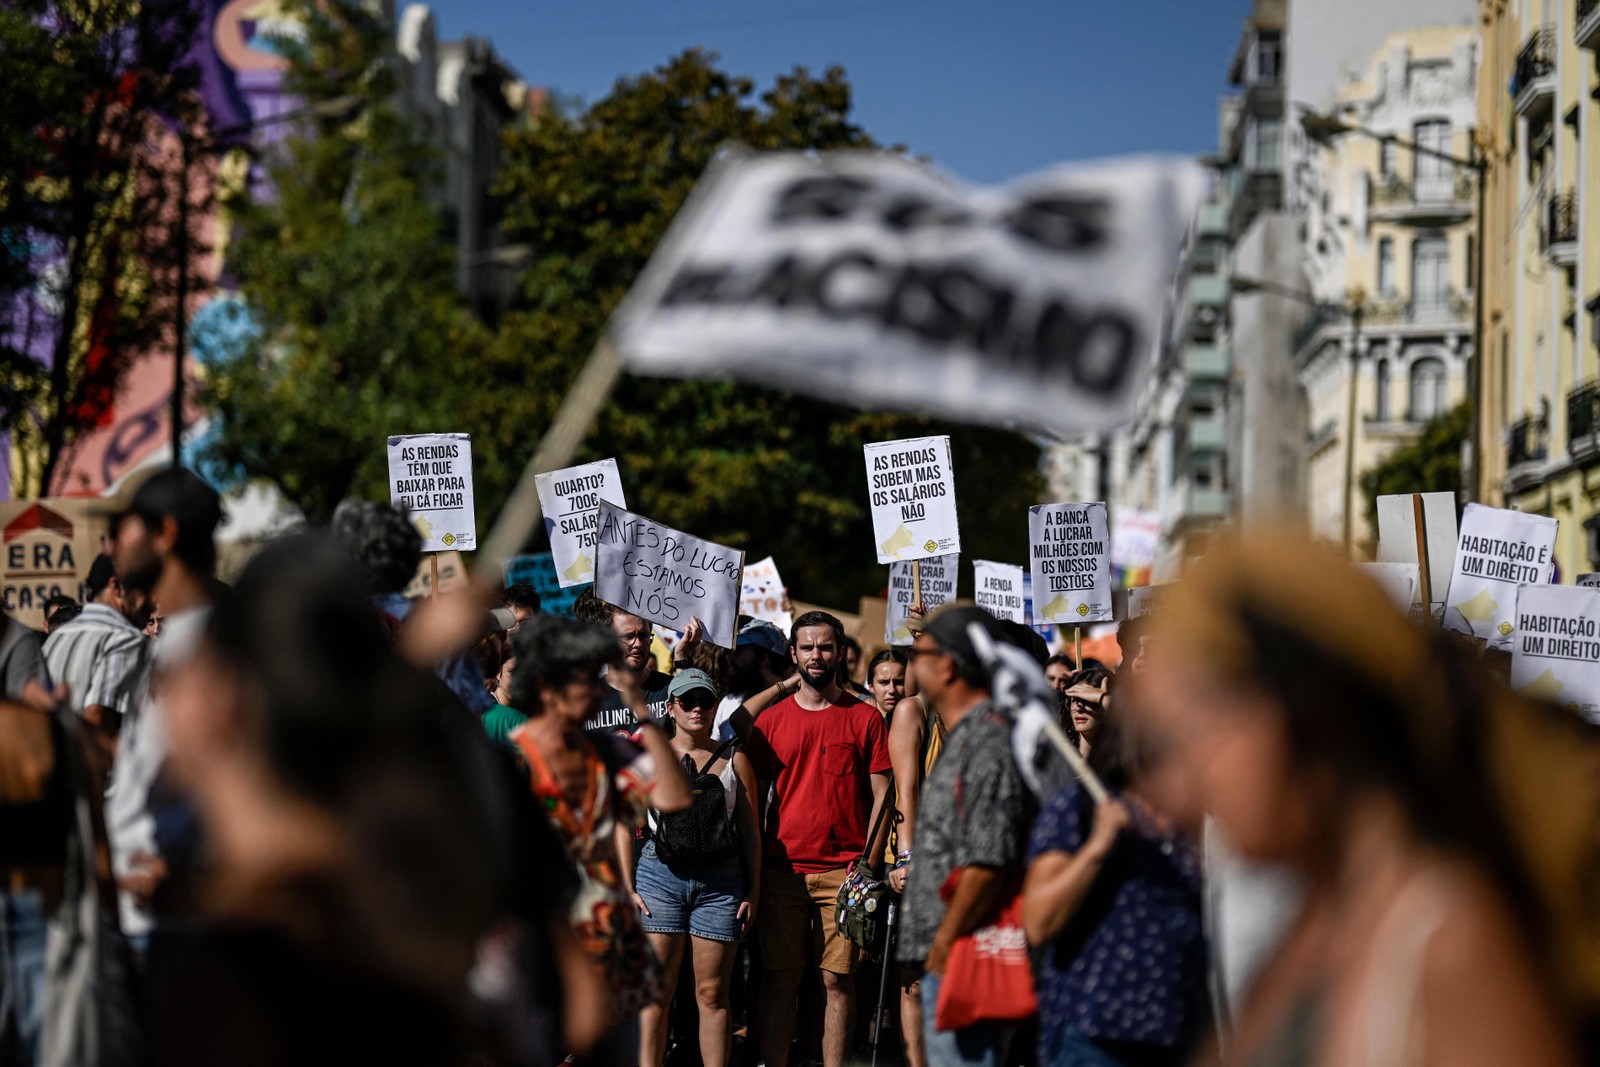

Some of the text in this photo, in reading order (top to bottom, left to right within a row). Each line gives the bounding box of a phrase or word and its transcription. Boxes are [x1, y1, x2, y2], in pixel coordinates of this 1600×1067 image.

[402, 445, 458, 460] AS RENDAS
[874, 448, 936, 471] AS RENDAS
[407, 461, 452, 476] TÊM QUE
[873, 464, 941, 489] SOBEM MAS
[397, 476, 465, 493] BAIXAR PARA
[554, 473, 605, 497] QUARTO?
[873, 482, 946, 506] OS SALÁRIOS
[417, 492, 430, 508] CÁ
[433, 493, 463, 507] FICAR
[568, 492, 598, 511] 700€
[901, 501, 925, 520] NÃO
[1046, 510, 1089, 526] A BANCA
[560, 513, 598, 534] SALÁR
[1044, 526, 1092, 541] A LUCRAR
[600, 512, 740, 580] ANTES DO LUCRO
[1034, 541, 1103, 558] MILHÕES COM
[1460, 534, 1548, 564] HABITAÇÃO É
[8, 542, 76, 570] ERA
[623, 552, 706, 598] ESTAMOS
[902, 564, 944, 579] A LCRAR
[1042, 558, 1097, 574] OS NOSSOS
[1462, 556, 1538, 584] UM DIREITO
[893, 577, 952, 592] MILHES COM
[984, 577, 1012, 592] A RENDA
[1049, 572, 1094, 589] TOSTÕES
[627, 586, 679, 620] NÓS
[897, 591, 945, 605] OS SSOS
[978, 591, 1020, 608] CUSTA O MEU
[1520, 614, 1595, 638] HABITAÇÃO
[1523, 636, 1600, 660] UM DIREITO
